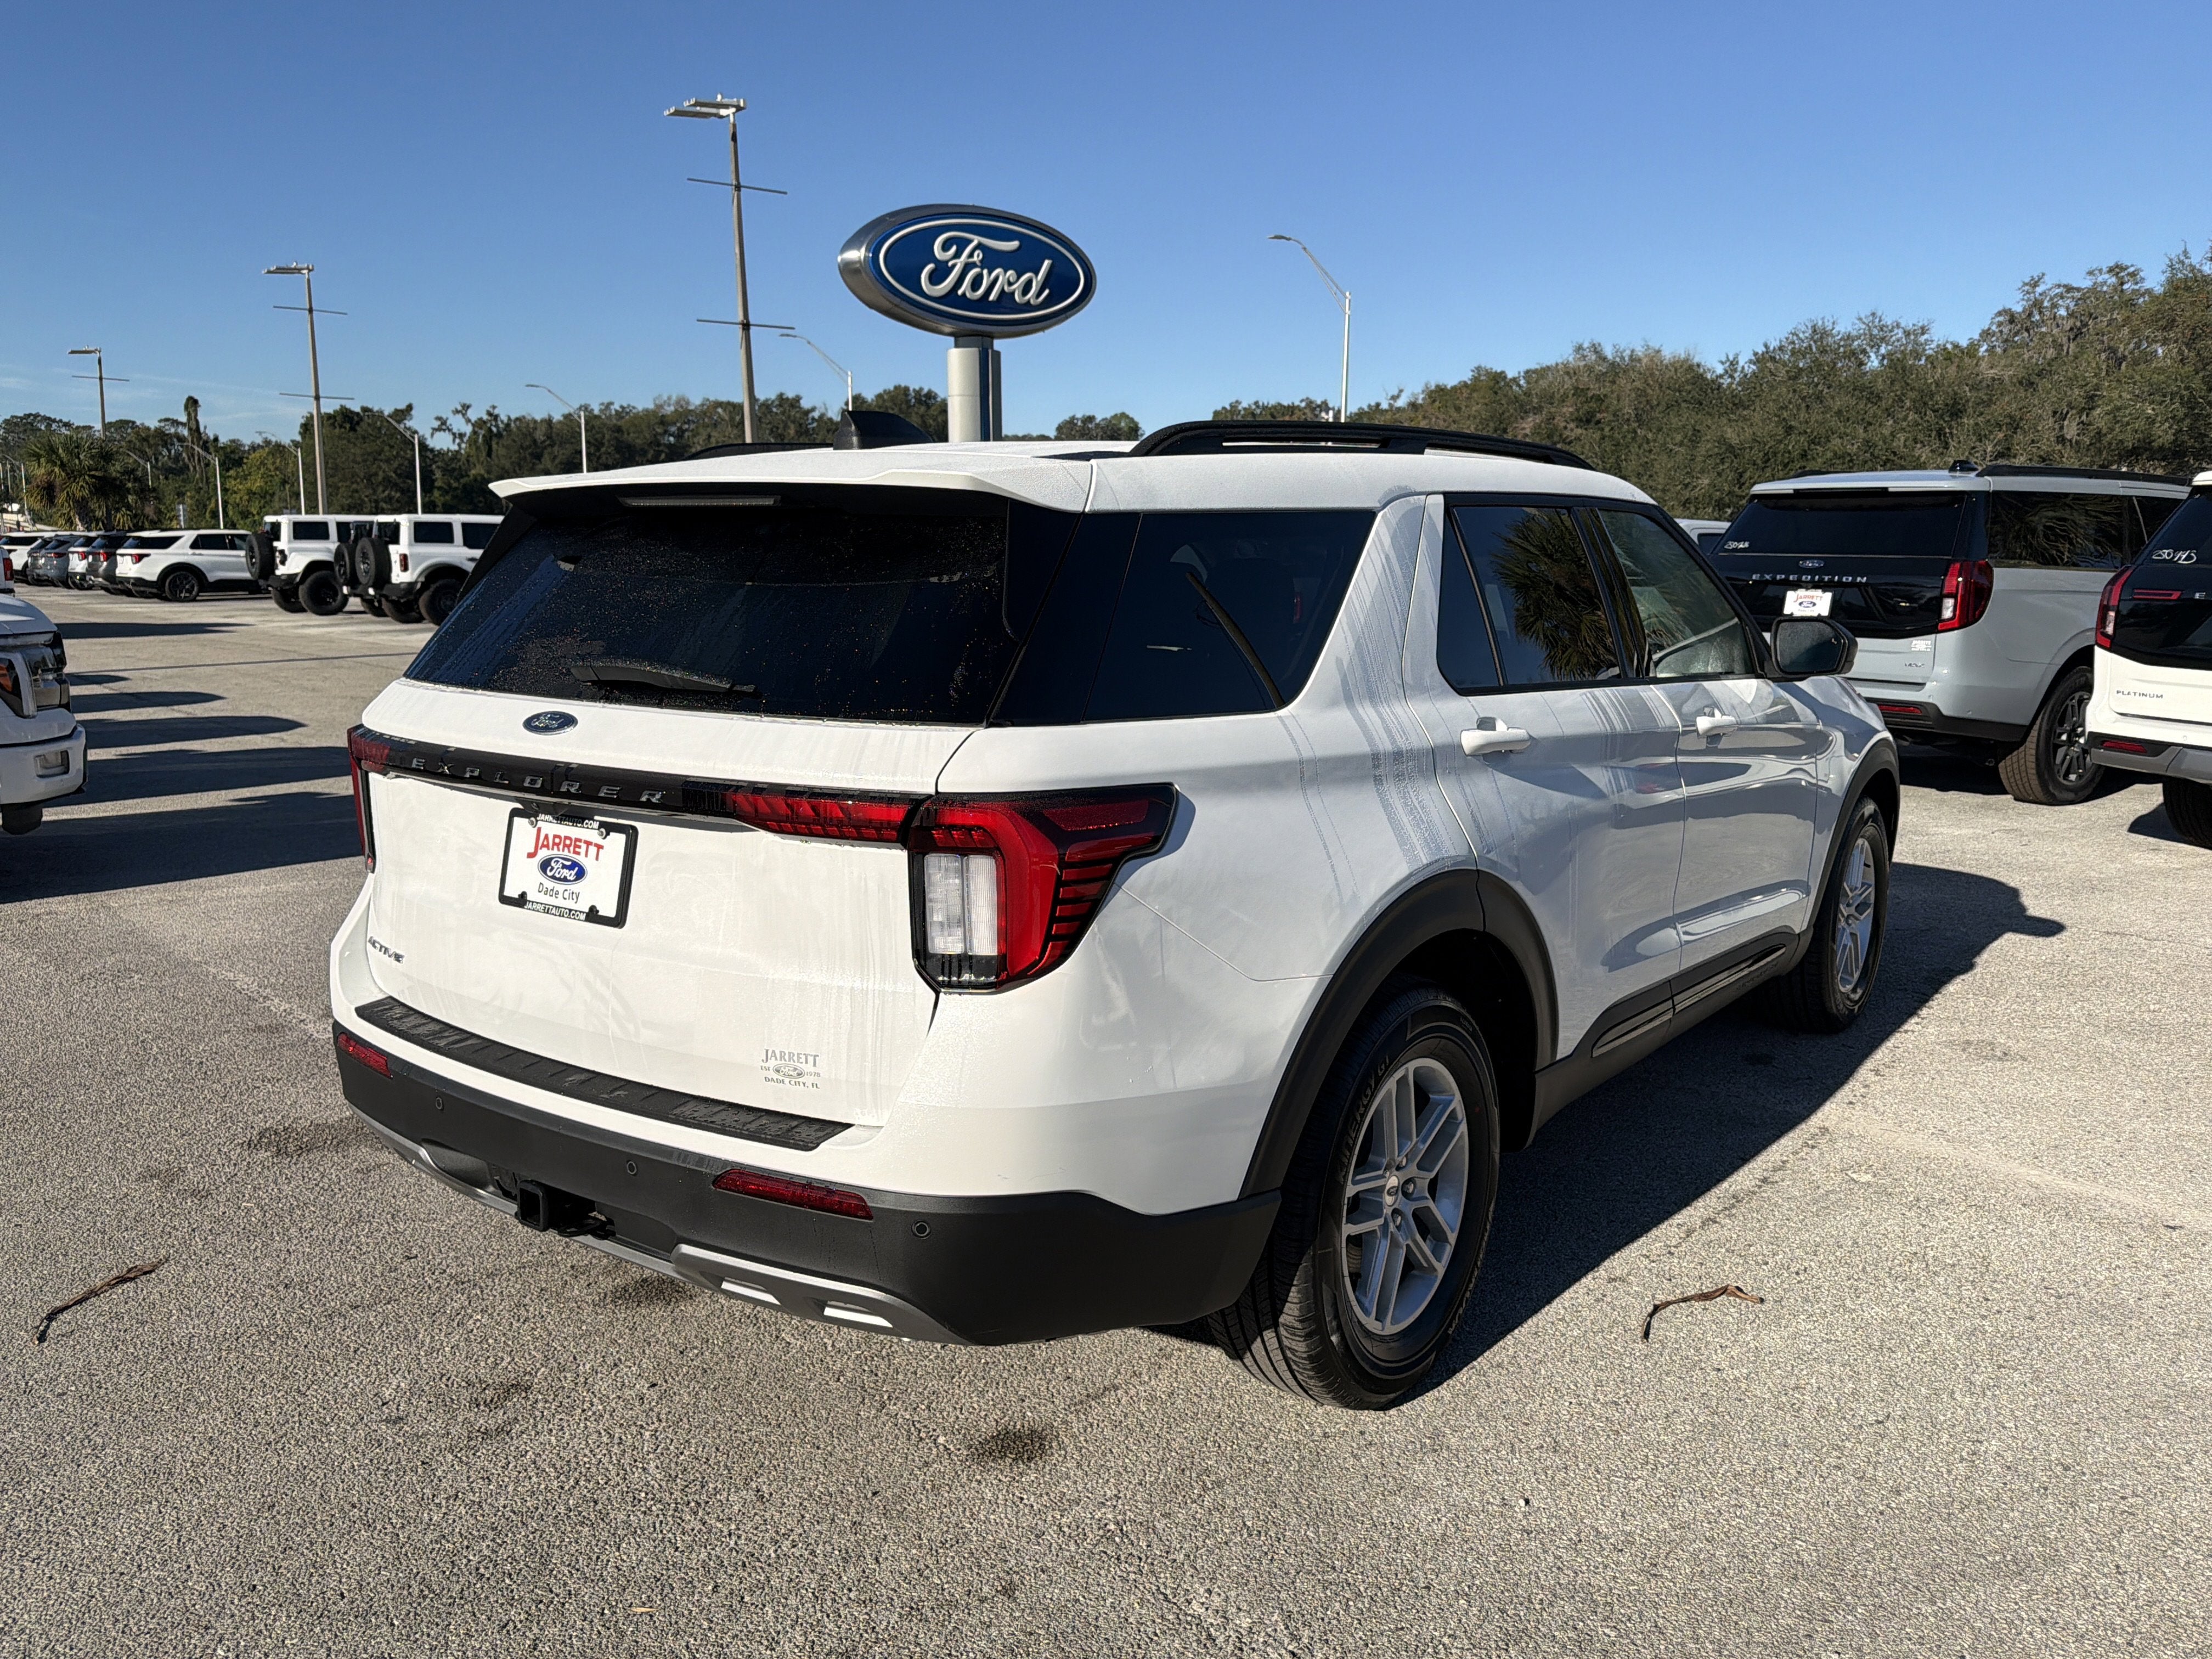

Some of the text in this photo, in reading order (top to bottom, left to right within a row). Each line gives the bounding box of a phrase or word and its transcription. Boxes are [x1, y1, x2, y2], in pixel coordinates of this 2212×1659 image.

[921, 231, 1053, 306] Ford
[1752, 573, 1867, 583] EXPEDITION
[2117, 690, 2163, 699] PLATINUM
[531, 713, 564, 729] Ford
[411, 757, 663, 804] EXPLORER
[537, 814, 600, 830] JARRETTAUTO.COM
[527, 827, 604, 861] JARRETT
[547, 857, 578, 881] Ford
[538, 882, 580, 904] Dade City
[524, 901, 586, 921] JARRETTAUTO.COM
[368, 936, 405, 964] ACTIVE
[761, 1048, 819, 1067] JARRETT
[780, 1066, 799, 1077] Ford
[764, 1076, 786, 1085] DADE
[789, 1080, 809, 1088] CITY,
